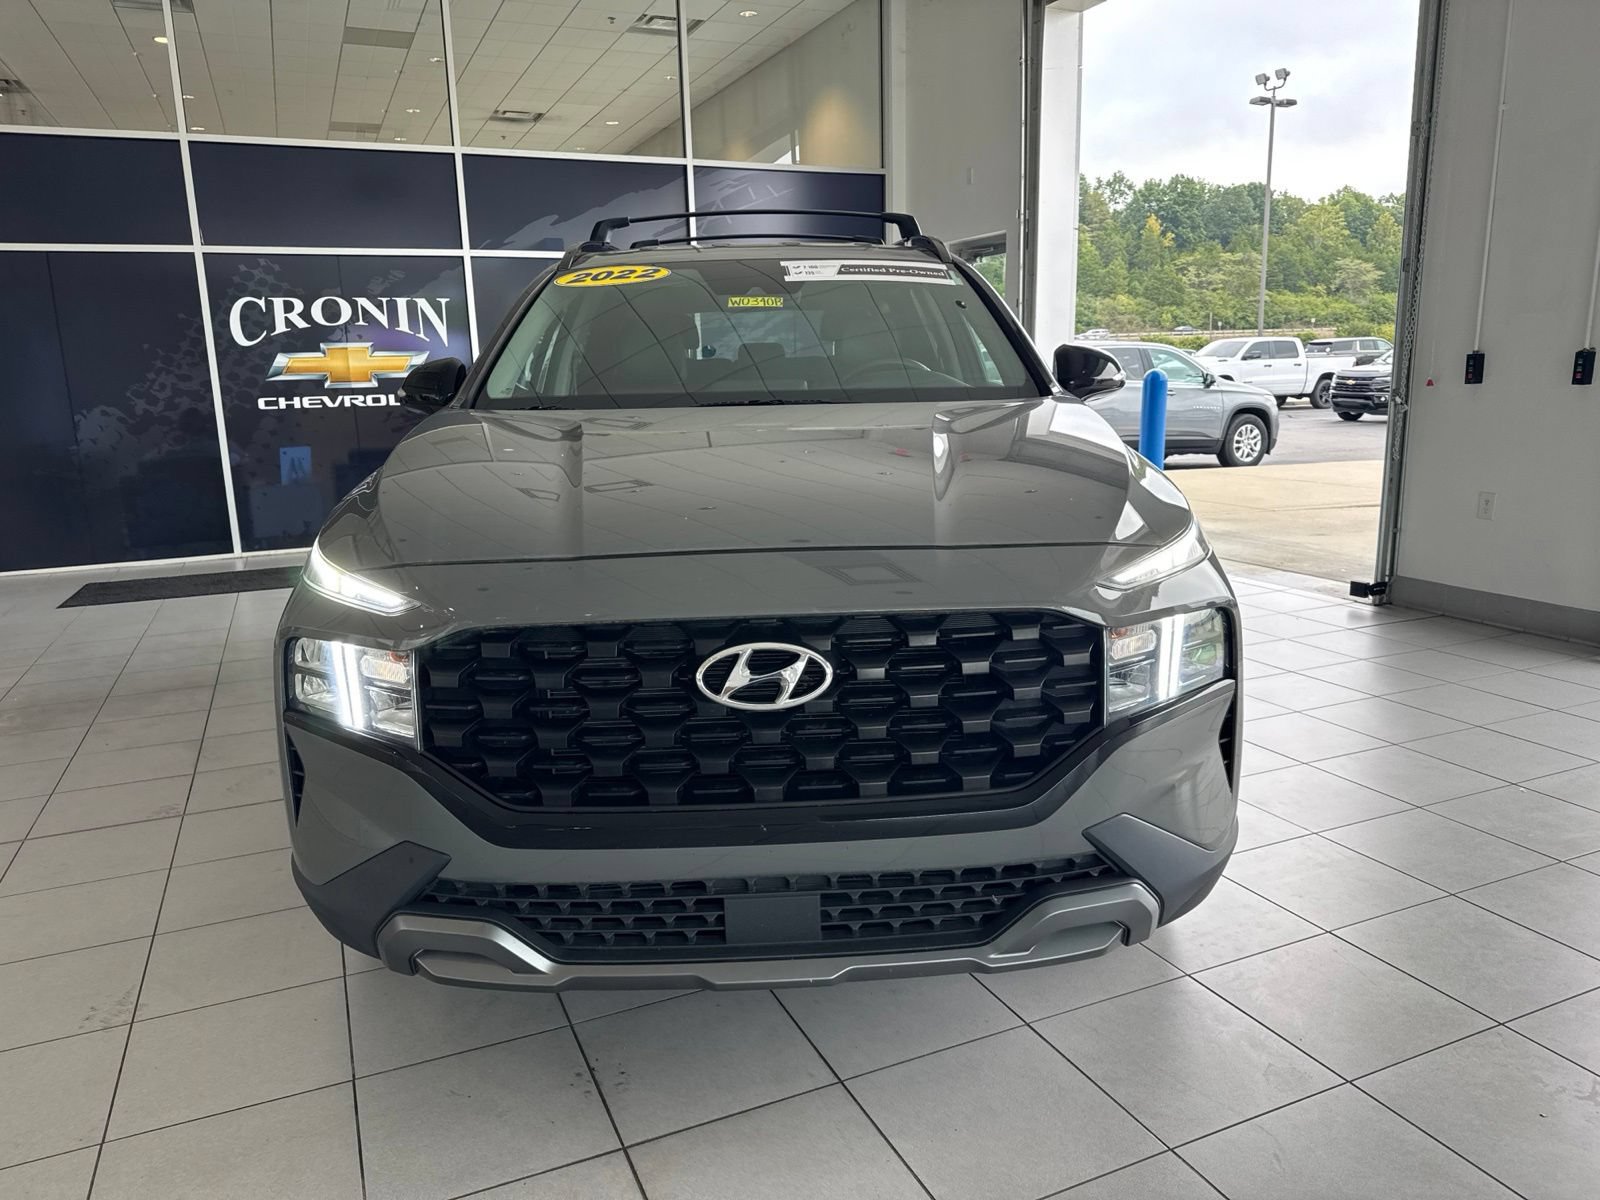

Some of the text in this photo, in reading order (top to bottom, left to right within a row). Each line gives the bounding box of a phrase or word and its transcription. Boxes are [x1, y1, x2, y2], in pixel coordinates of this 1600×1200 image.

[566, 268, 661, 284] 2022
[840, 266, 887, 274] Certified
[888, 267, 945, 276] Pre-Owned
[229, 296, 450, 347] CRONIN
[257, 394, 401, 410] CHEVROL
